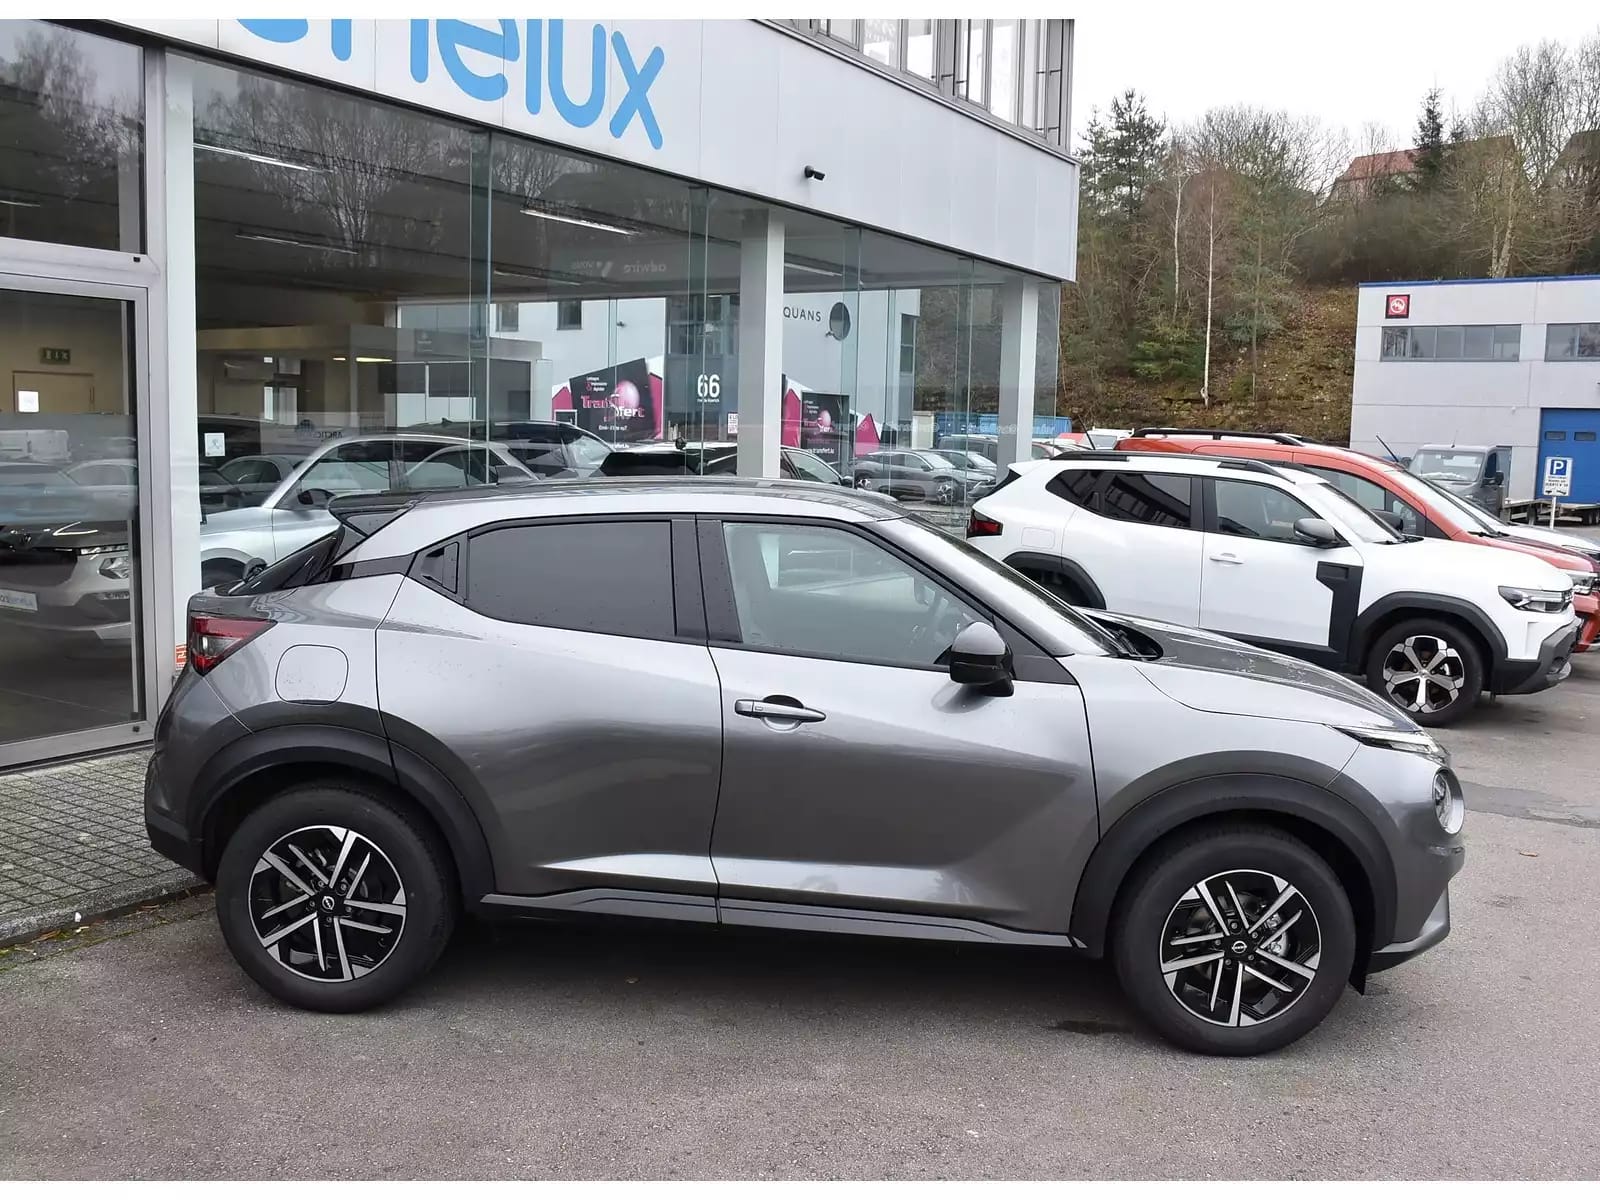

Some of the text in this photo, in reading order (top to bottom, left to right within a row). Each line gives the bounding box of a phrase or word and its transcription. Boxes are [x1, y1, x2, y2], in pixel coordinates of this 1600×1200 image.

[236, 19, 665, 150] elux
[697, 374, 720, 398] 66
[1553, 460, 1565, 475] P
